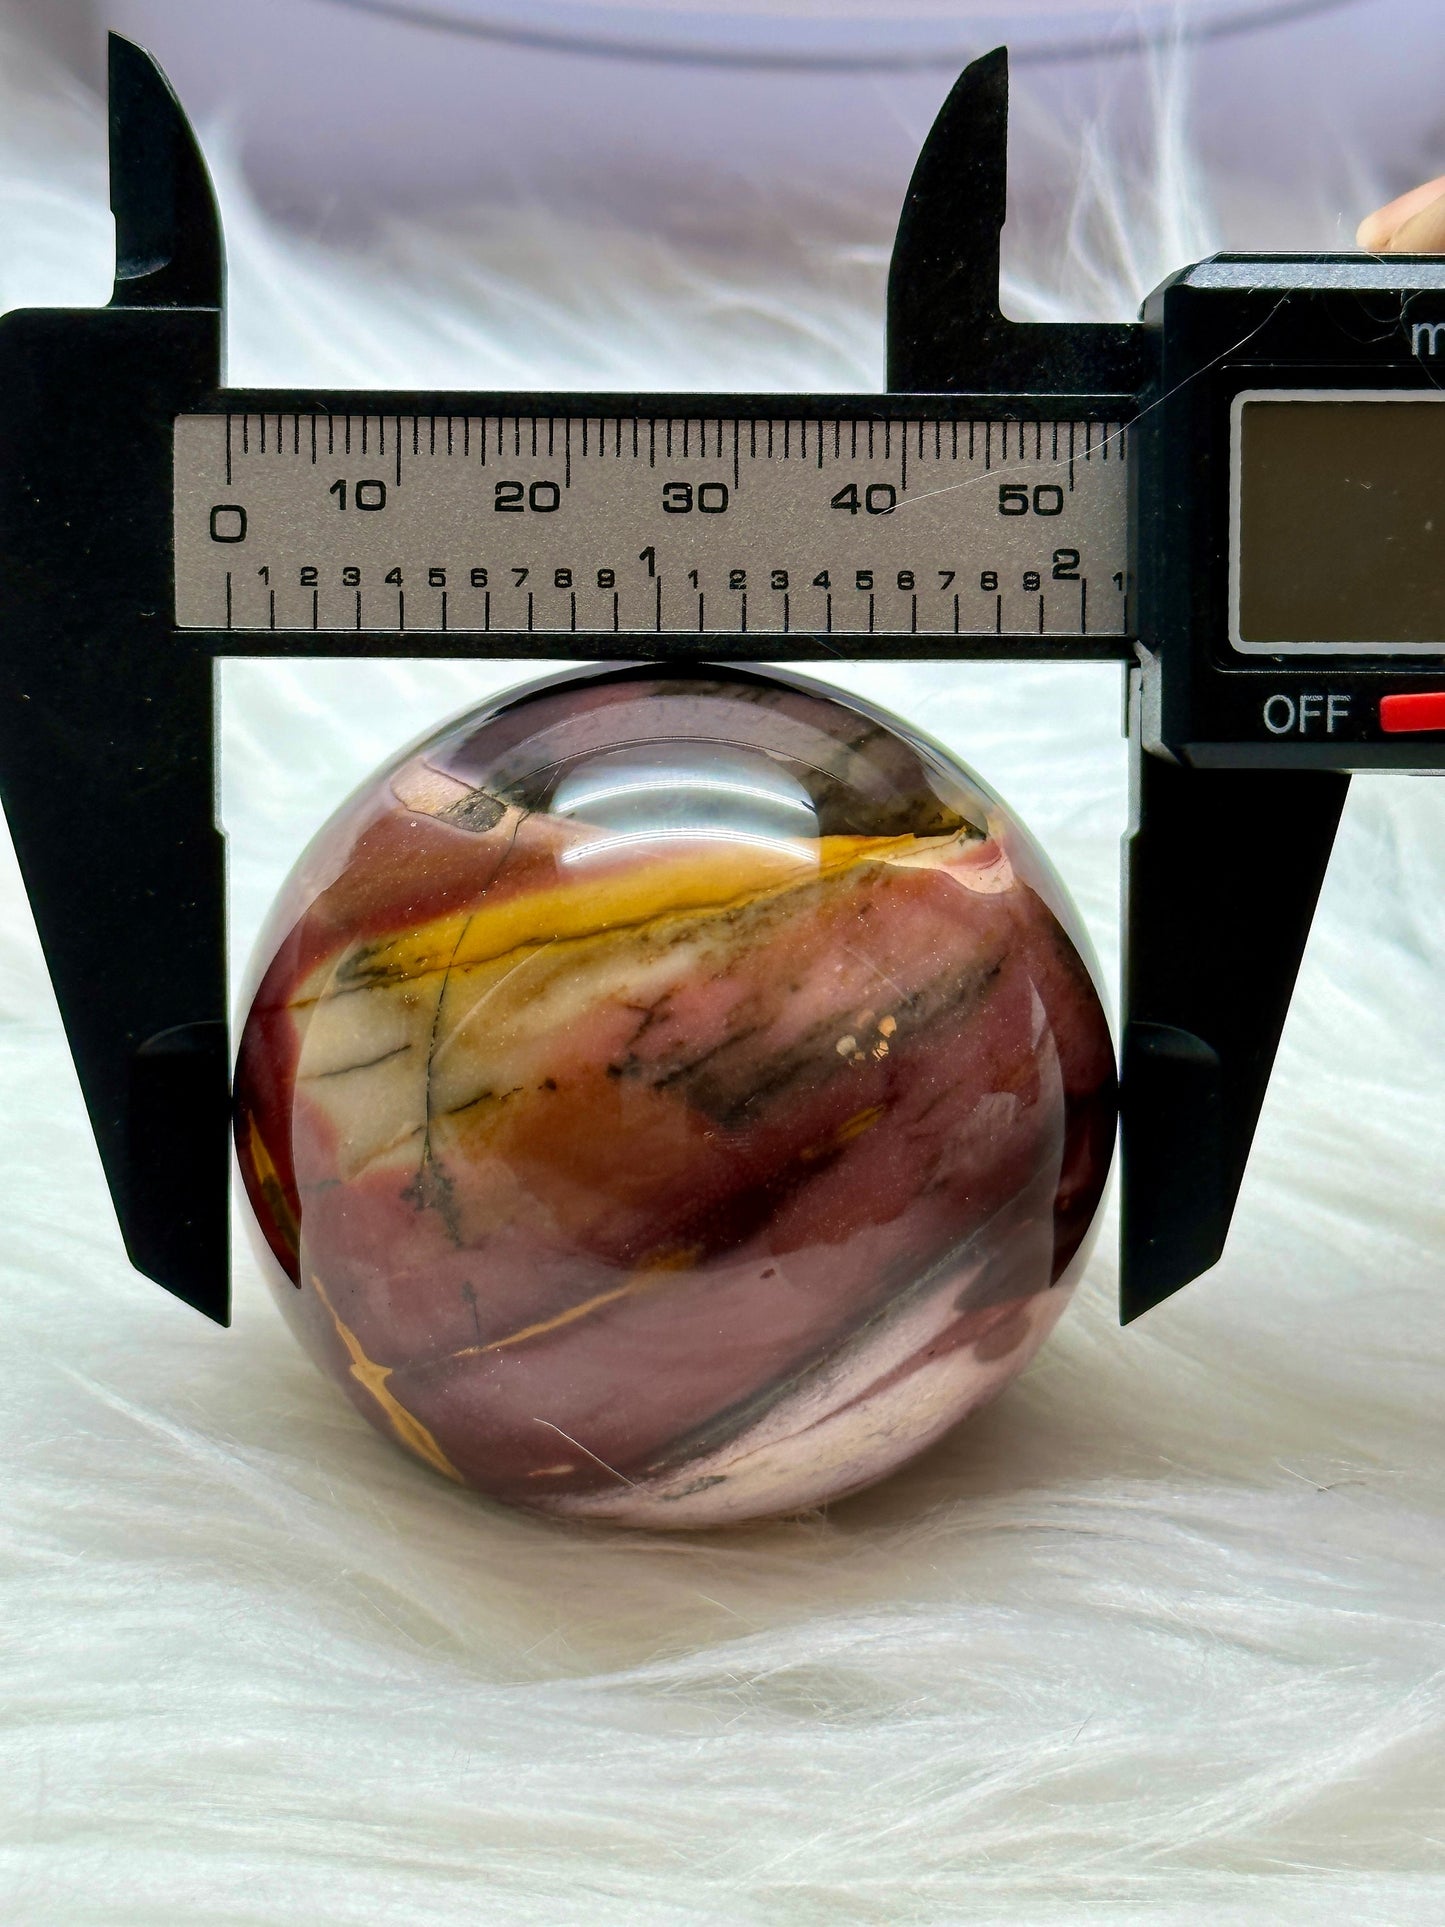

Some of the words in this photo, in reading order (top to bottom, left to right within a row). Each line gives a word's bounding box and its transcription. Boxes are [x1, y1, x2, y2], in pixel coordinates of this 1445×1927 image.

[209, 504, 248, 544] 0
[329, 478, 387, 512] 10
[494, 480, 561, 514] 20
[662, 481, 729, 515] 30
[830, 483, 897, 516] 40
[998, 483, 1065, 517] 50
[257, 565, 270, 586] 1
[299, 565, 319, 587] 2
[342, 566, 361, 588] 3
[384, 566, 404, 588] 4
[427, 567, 447, 588] 5
[470, 567, 489, 589] 6
[510, 567, 530, 588] 7
[553, 567, 573, 590] 8
[596, 568, 616, 590] 9
[638, 545, 656, 578] 1
[687, 569, 699, 590] 1
[728, 568, 747, 591] 2
[770, 569, 790, 591] 3
[812, 569, 832, 591] 4
[855, 569, 874, 591] 5
[896, 569, 916, 592] 6
[937, 570, 956, 591] 7
[979, 570, 999, 592] 8
[1022, 570, 1041, 592] 9
[1051, 548, 1081, 582] 2
[1111, 570, 1124, 592] 1
[1262, 694, 1352, 735] OFF
